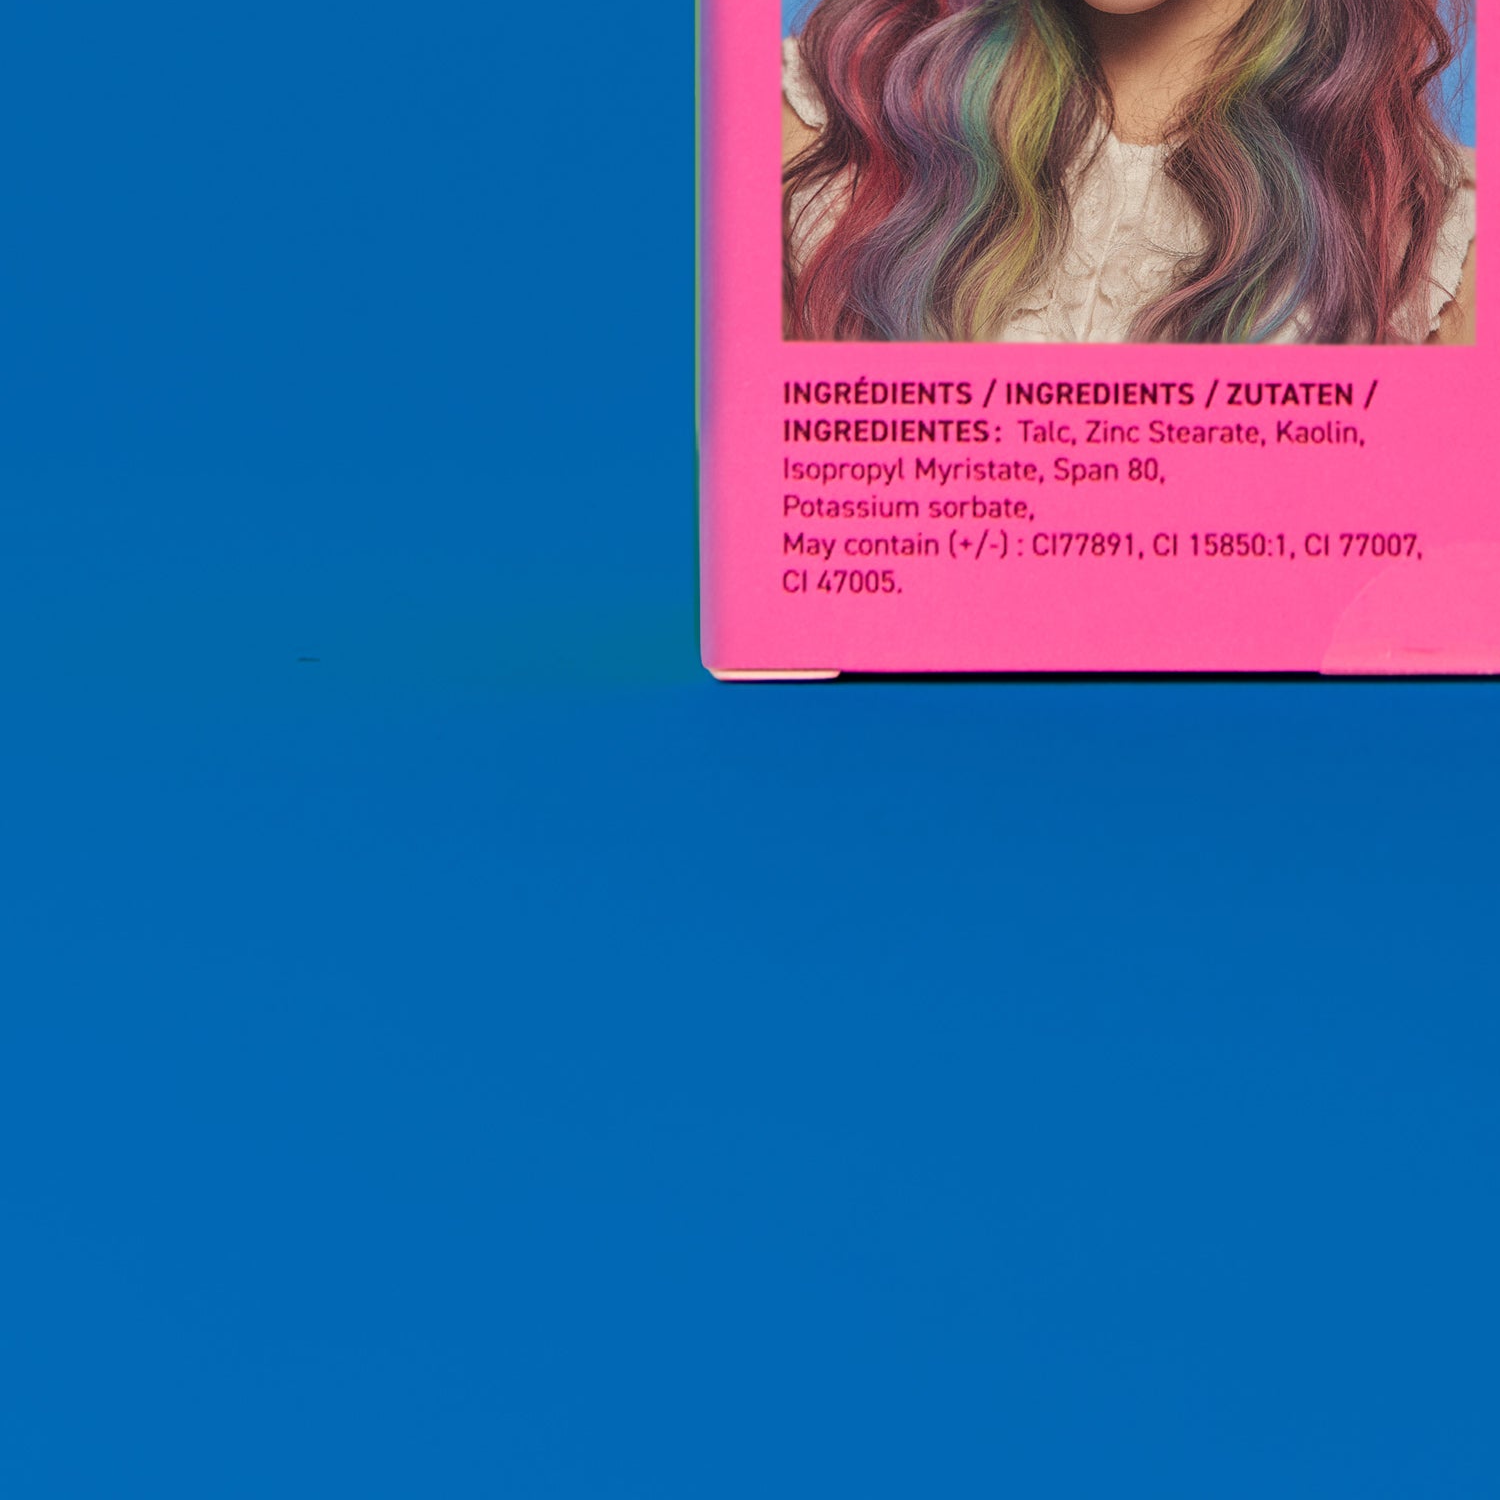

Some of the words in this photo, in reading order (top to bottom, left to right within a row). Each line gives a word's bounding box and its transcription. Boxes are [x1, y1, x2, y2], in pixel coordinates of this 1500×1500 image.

[783, 375, 973, 405] INGRÉDIENTS
[1005, 381, 1195, 406] INGREDIENTS
[1226, 382, 1354, 406] ZUTATEN
[1017, 419, 1077, 446] Talc,
[1086, 419, 1139, 443] Zinc
[1148, 419, 1266, 447] Stearate,
[1276, 420, 1365, 447] Kaolin,
[784, 457, 903, 486] Isopropyl
[915, 457, 1045, 487] Myristate,
[1053, 457, 1119, 486] Span
[1127, 457, 1165, 485] 80,
[783, 494, 920, 518] Potassium
[928, 494, 1035, 522] sorbate,
[783, 531, 836, 561] May
[843, 535, 940, 556] contain
[1032, 532, 1144, 560] CI77891,
[1152, 532, 1178, 557] CI
[1191, 532, 1296, 560] 15850:1,
[1304, 532, 1330, 557] CI
[1339, 533, 1422, 560] 77007,
[782, 569, 808, 593] CI
[816, 569, 902, 594] 47005.
